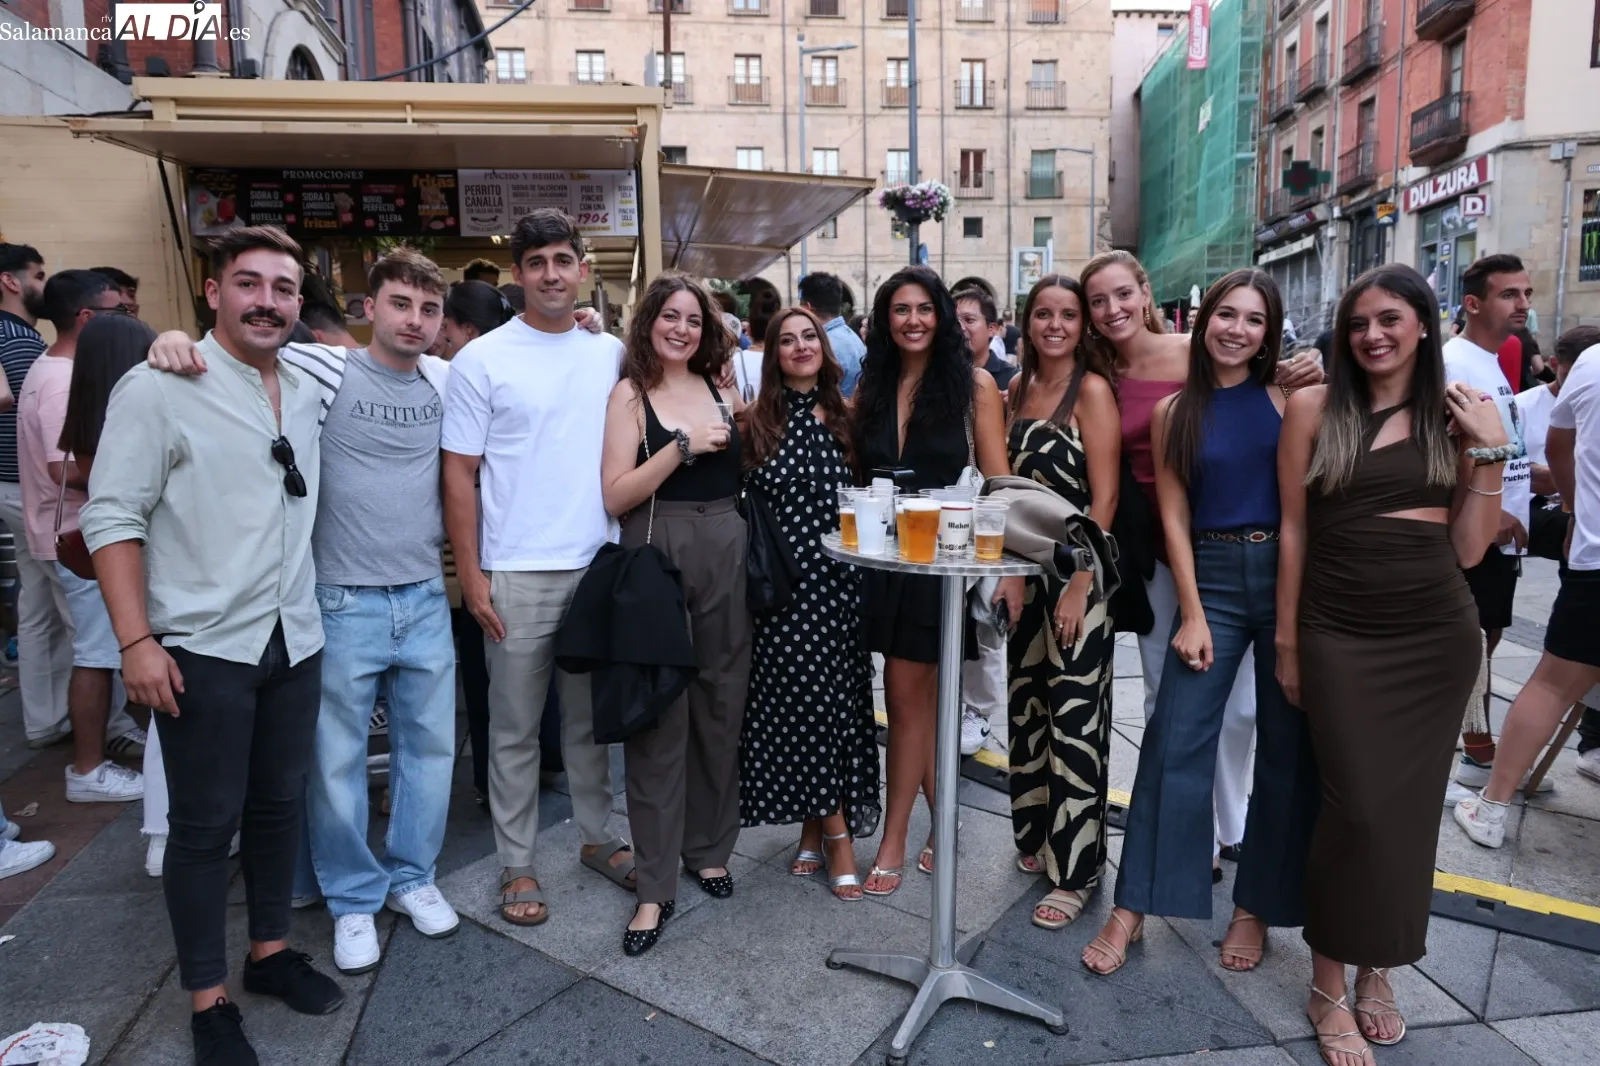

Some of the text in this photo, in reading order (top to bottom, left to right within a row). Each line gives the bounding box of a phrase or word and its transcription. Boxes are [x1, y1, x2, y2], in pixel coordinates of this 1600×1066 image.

[282, 170, 364, 179] PROMOCIONES
[484, 172, 519, 181] PINCHO
[523, 172, 529, 181] Y
[532, 172, 565, 180] BEBIDA
[412, 174, 456, 188] fritas
[1410, 162, 1479, 209] DULZURA
[464, 184, 502, 195] PERRITO
[302, 192, 324, 201] SIDRA
[465, 196, 504, 207] CANALLA
[363, 204, 395, 212] PERFECTO
[512, 206, 530, 215] BOLA
[251, 213, 283, 221] BOTELLA
[378, 214, 402, 222] YLLERA
[577, 212, 609, 224] 1906
[350, 400, 440, 421] ATTITUDE
